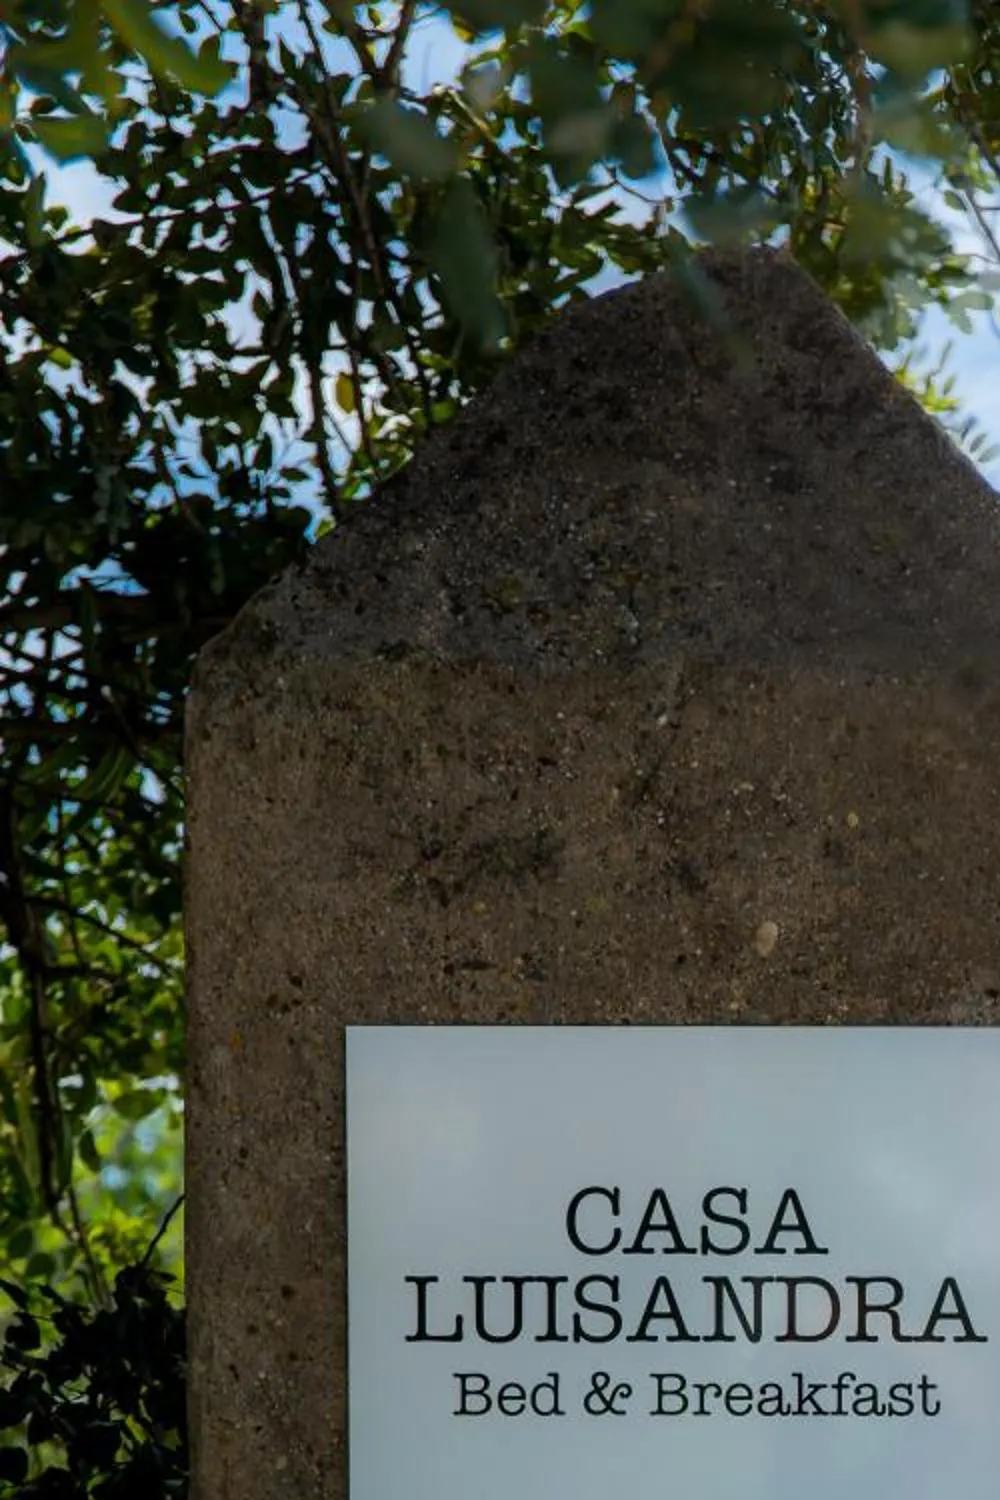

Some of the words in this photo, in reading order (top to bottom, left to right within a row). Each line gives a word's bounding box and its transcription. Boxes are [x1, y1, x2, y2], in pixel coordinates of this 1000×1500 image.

[565, 1185, 830, 1257] CASA
[403, 1273, 989, 1345] LUISANDRA
[451, 1371, 567, 1417] Bed
[582, 1371, 634, 1417] &
[648, 1370, 943, 1417] Breakfast
